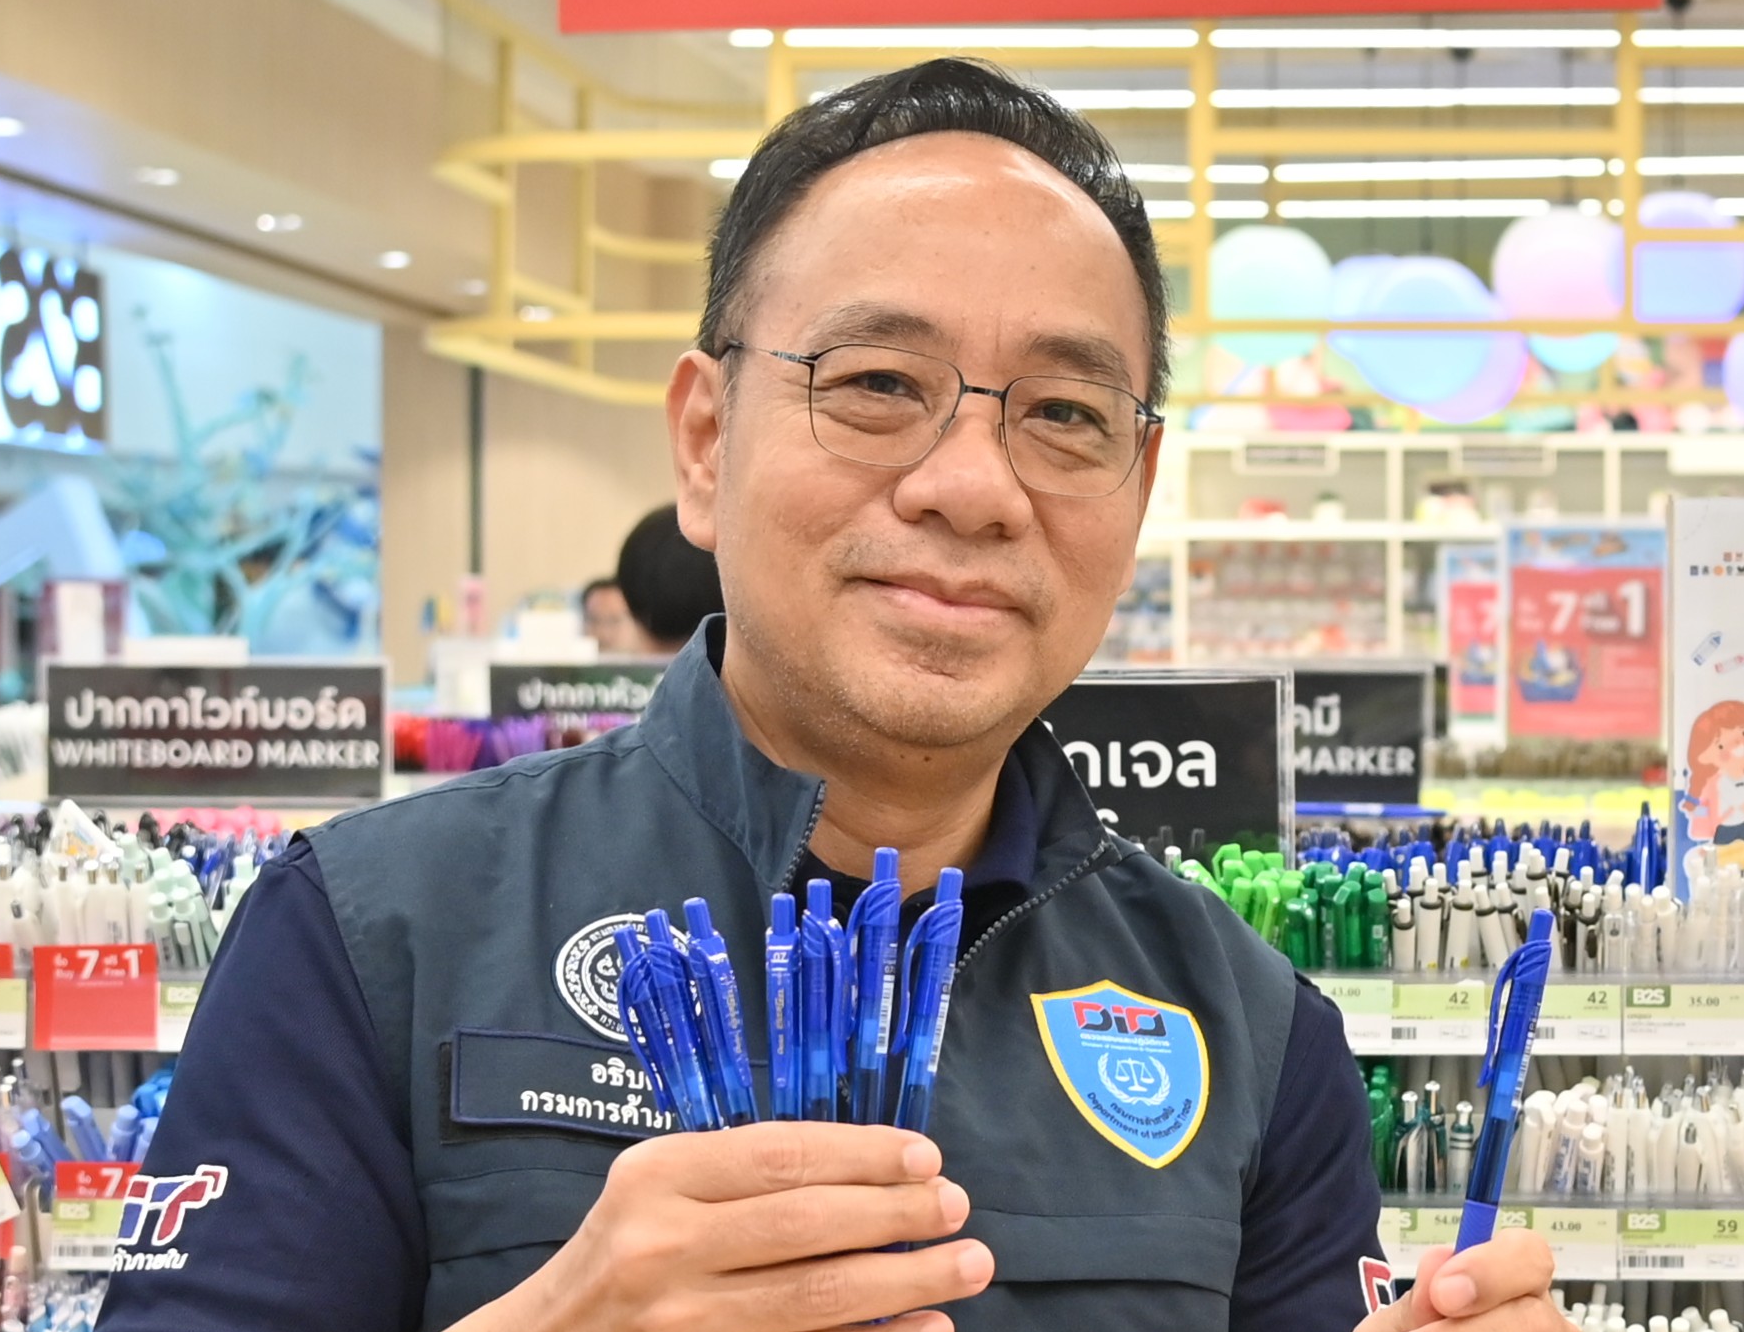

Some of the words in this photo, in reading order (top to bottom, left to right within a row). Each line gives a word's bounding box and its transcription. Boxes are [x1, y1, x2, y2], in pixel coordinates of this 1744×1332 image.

[1547, 591, 1578, 634] 7
[1618, 580, 1645, 637] 1
[64, 686, 366, 730] ปากกาไวท์บอร์ด
[52, 738, 254, 768] WHITEBOARD
[258, 739, 380, 768] MARKER
[76, 949, 100, 980] 7
[122, 949, 140, 979] 1
[1448, 991, 1469, 1005] 42
[1586, 990, 1608, 1005] 42
[1632, 988, 1665, 1005] B2S
[1690, 996, 1720, 1007] 35.00
[1087, 1092, 1139, 1136] Department
[1141, 1130, 1151, 1139] of
[1550, 1220, 1582, 1232] 43.00
[1716, 1219, 1738, 1234] 59
